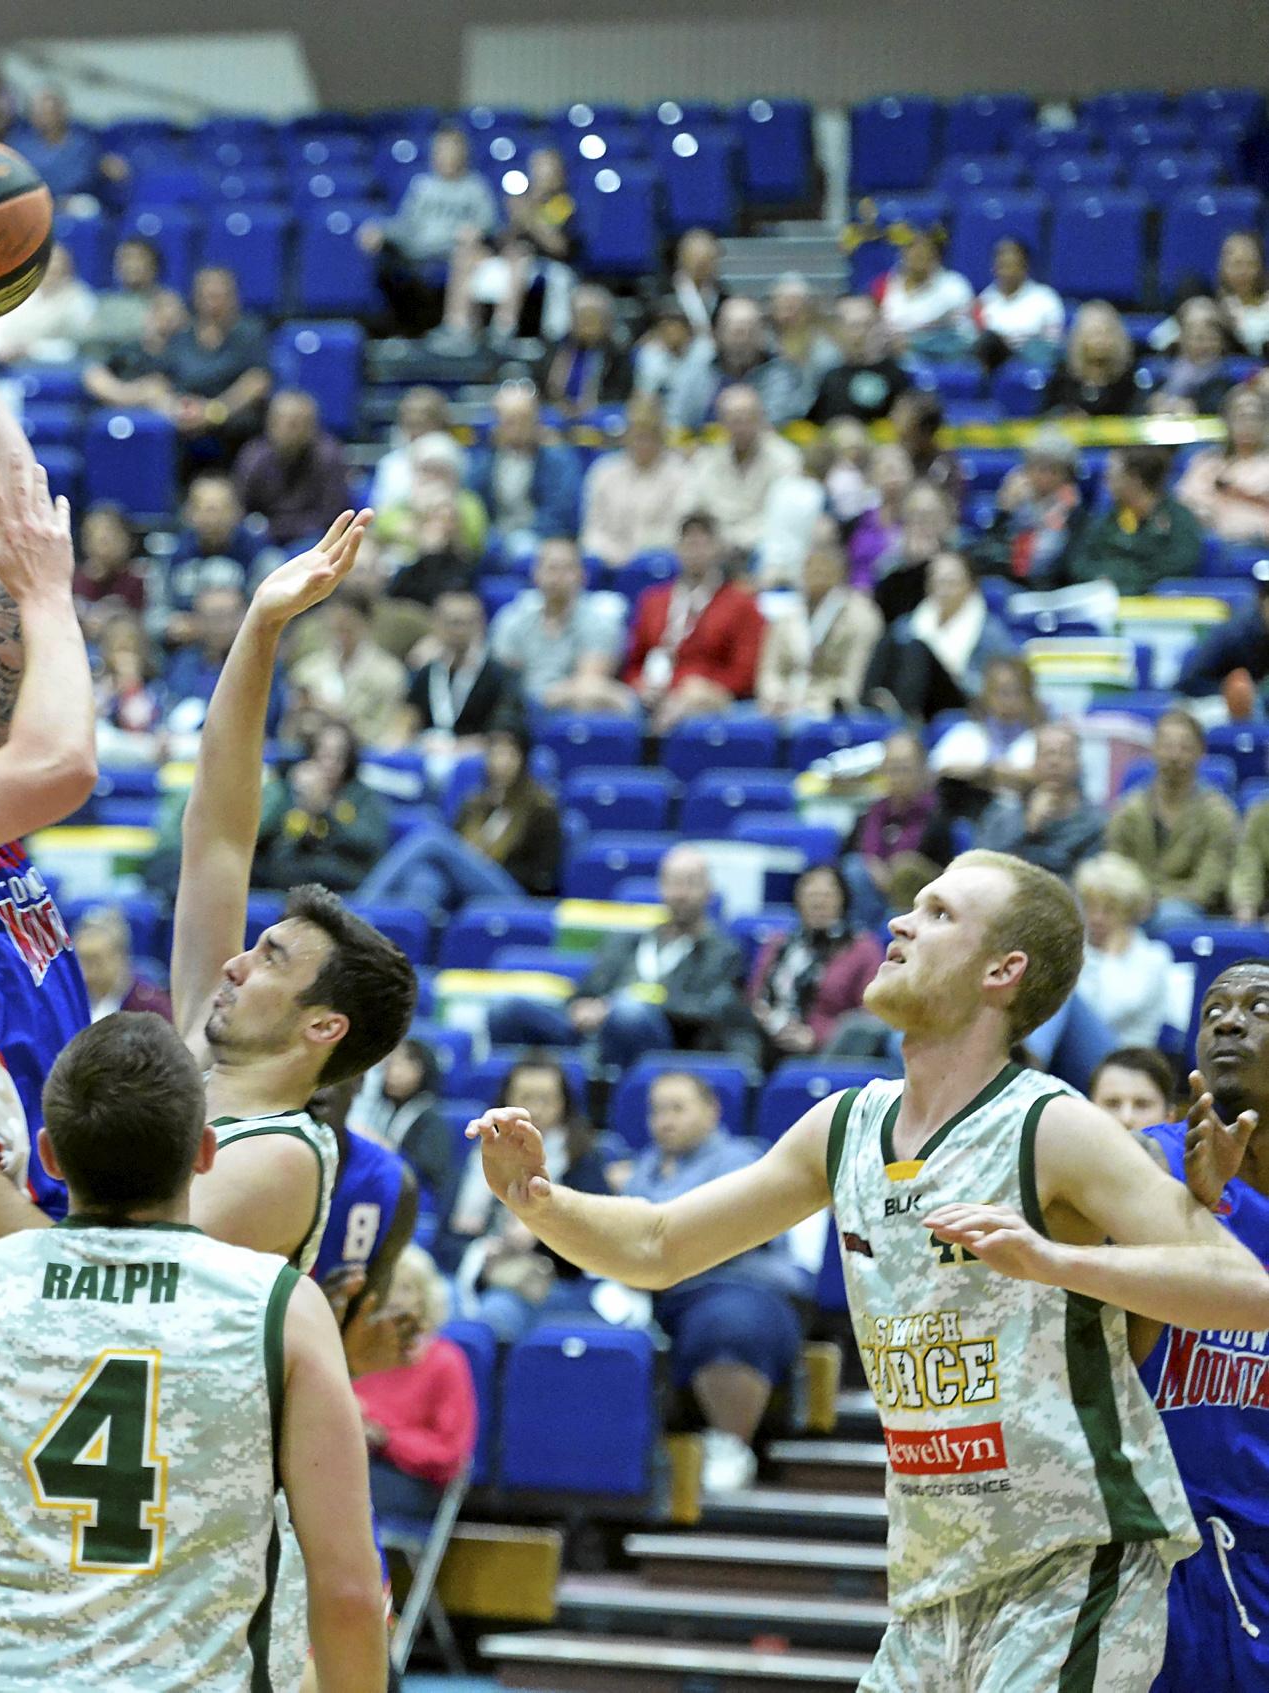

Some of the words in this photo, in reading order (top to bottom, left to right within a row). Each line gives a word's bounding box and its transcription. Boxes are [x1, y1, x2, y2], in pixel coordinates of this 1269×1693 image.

[884, 1194, 923, 1216] BLK
[342, 1202, 381, 1262] 8
[41, 1262, 180, 1304] RALPH
[865, 1310, 963, 1348] SWICH
[23, 1349, 168, 1574] 4
[887, 1432, 998, 1470] lewellyn
